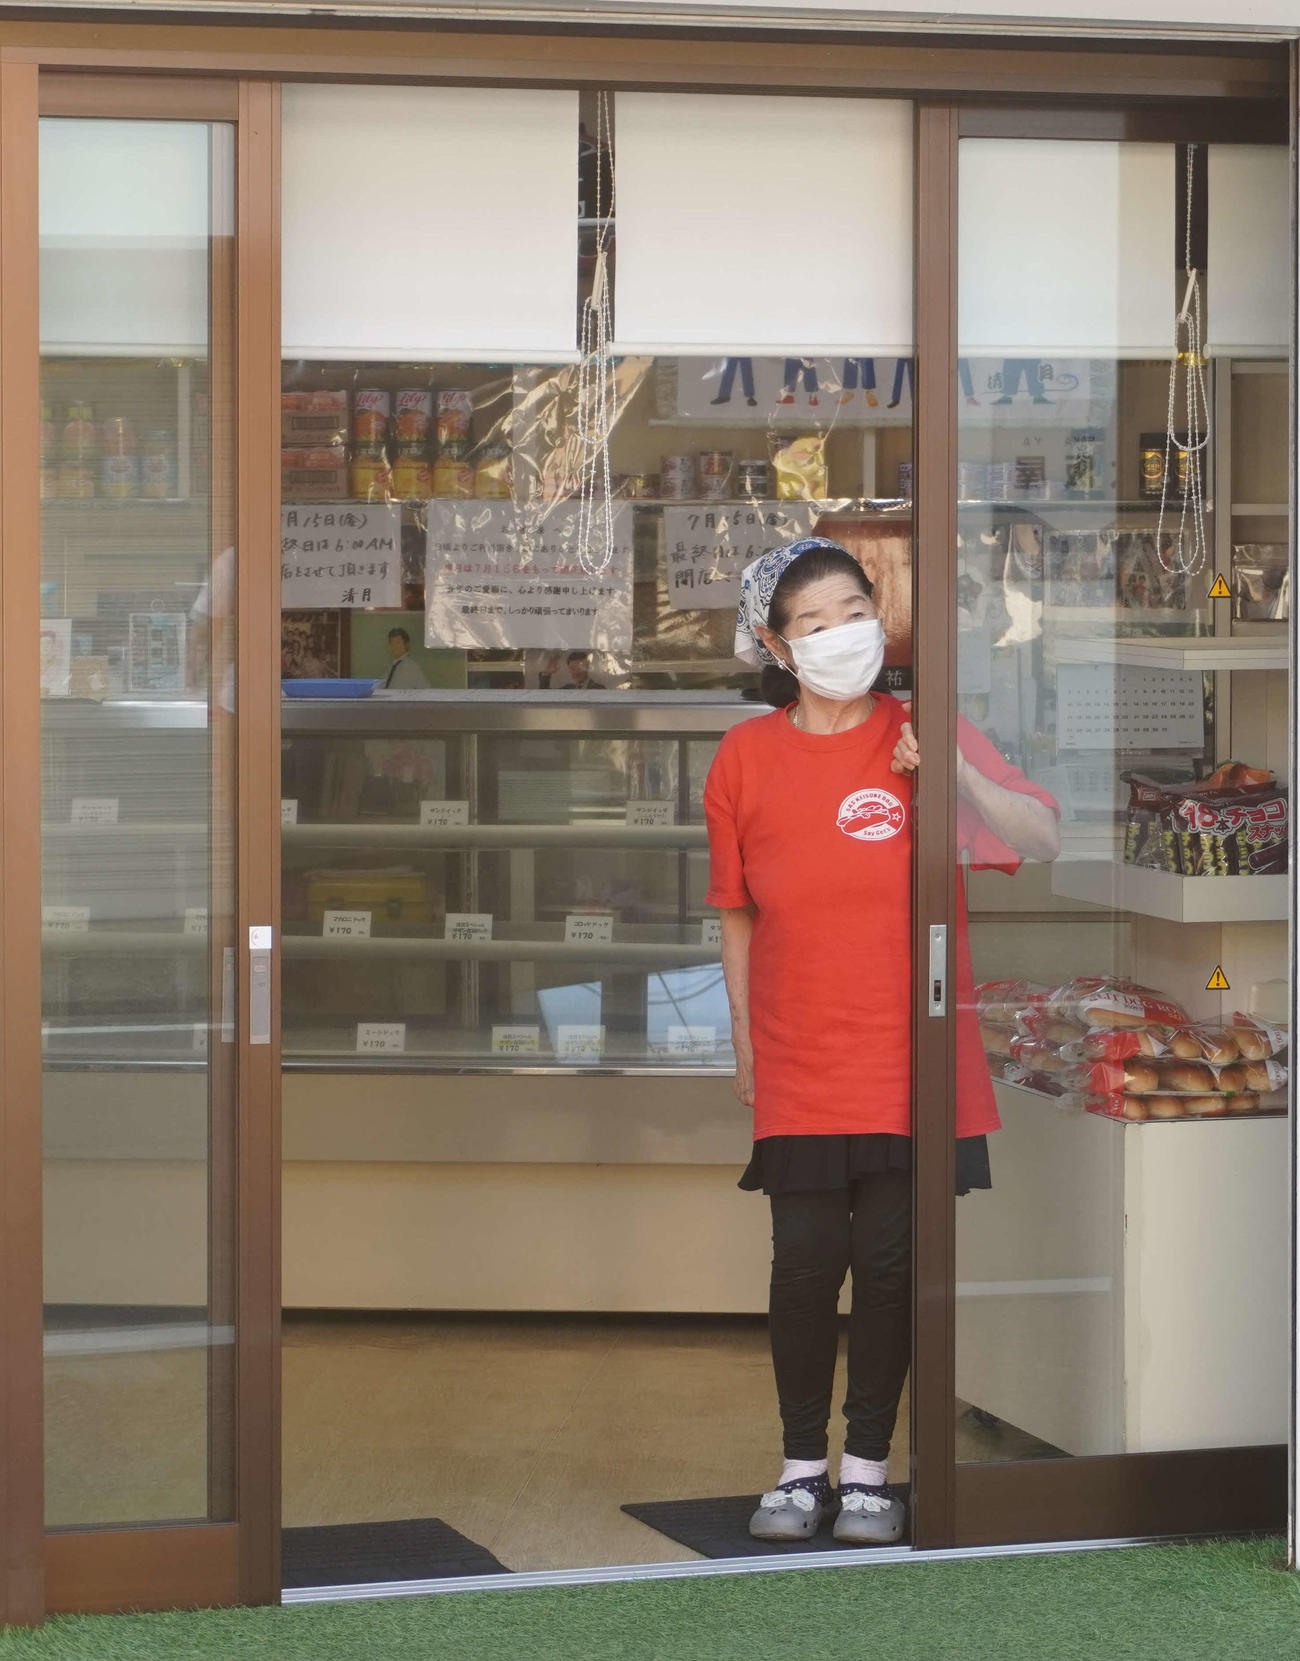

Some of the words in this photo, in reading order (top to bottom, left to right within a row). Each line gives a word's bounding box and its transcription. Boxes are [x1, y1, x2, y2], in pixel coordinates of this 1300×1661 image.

[341, 587, 372, 603] 清月
[329, 927, 352, 935] ¥170
[571, 931, 594, 940] ¥170
